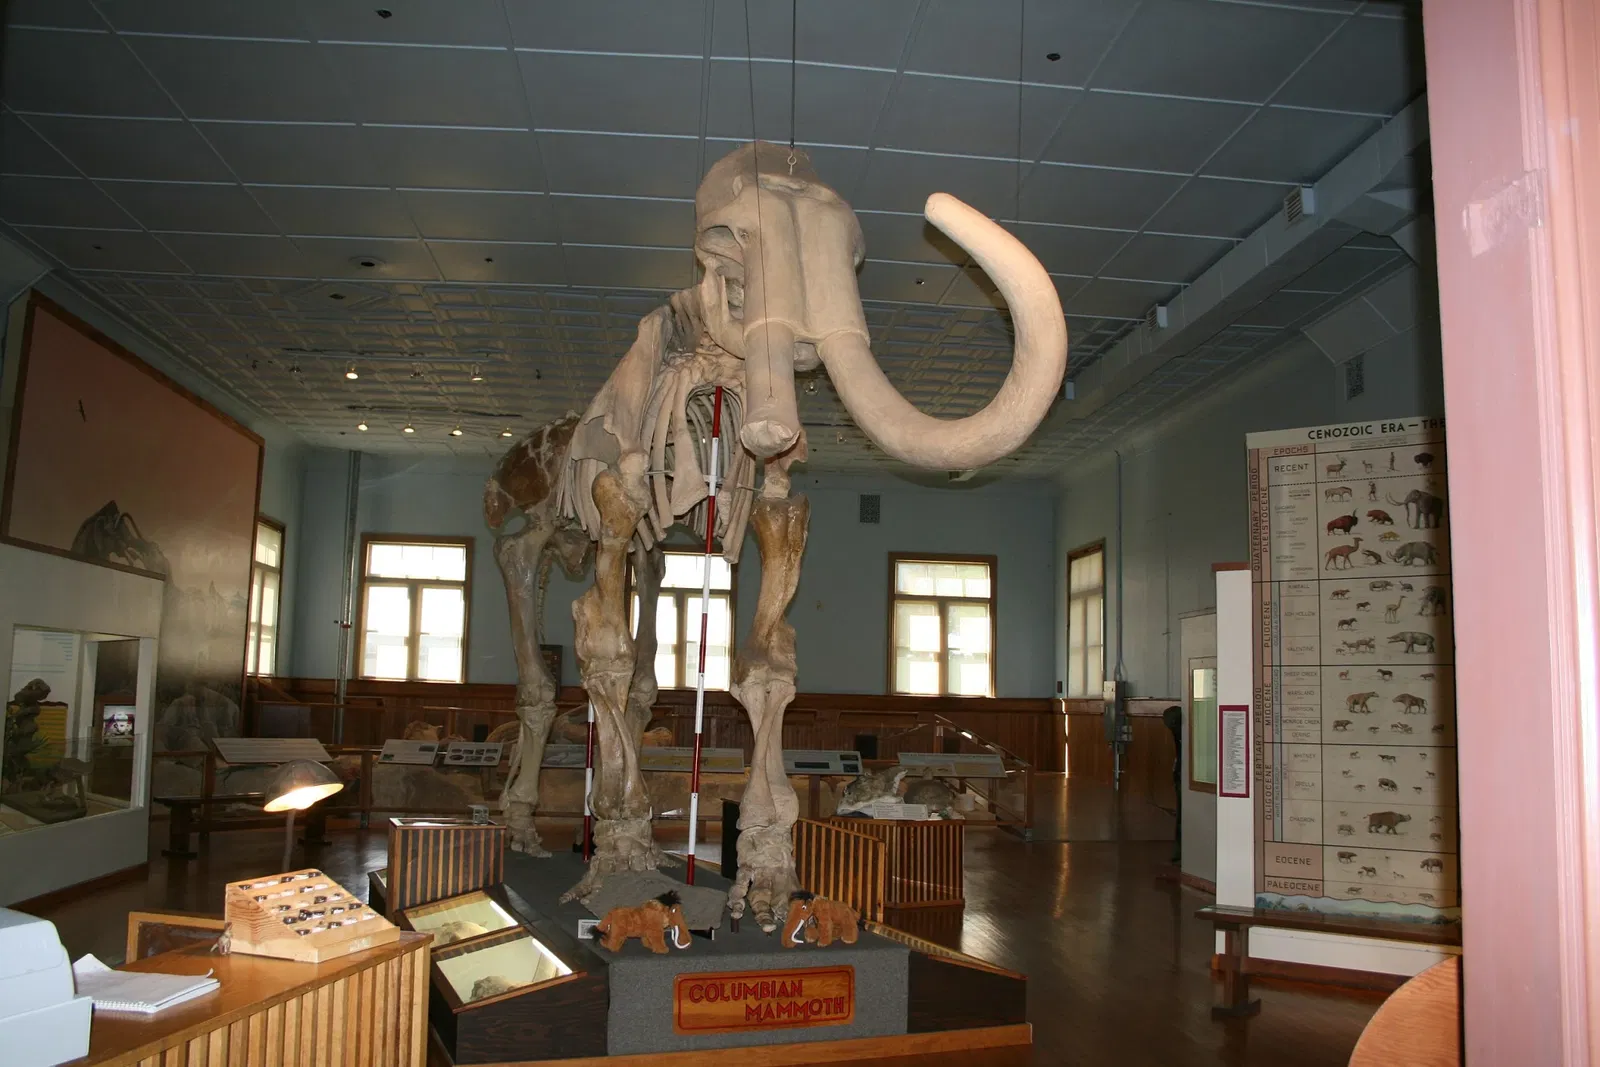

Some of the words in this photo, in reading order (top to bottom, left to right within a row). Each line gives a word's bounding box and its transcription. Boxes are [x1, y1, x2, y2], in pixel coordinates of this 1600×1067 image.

[1307, 425, 1373, 440] CENOZOIC
[1381, 422, 1405, 434] ERA
[1273, 446, 1309, 456] EPOCHS
[1274, 463, 1310, 473] RECENT
[1250, 467, 1258, 502] PERIOD
[1261, 486, 1269, 553] PLEISTOCENE
[1252, 510, 1261, 571] QUATERNARY
[1263, 599, 1271, 648] PLIOCENE
[1264, 682, 1272, 727] MIOCENE
[1255, 733, 1263, 783] TERTIARY
[1275, 855, 1312, 866] EOCENE
[1266, 881, 1320, 892] PALEOCENE
[688, 979, 804, 1002] COLUMBIAN
[745, 996, 845, 1022] MAMMOTH
